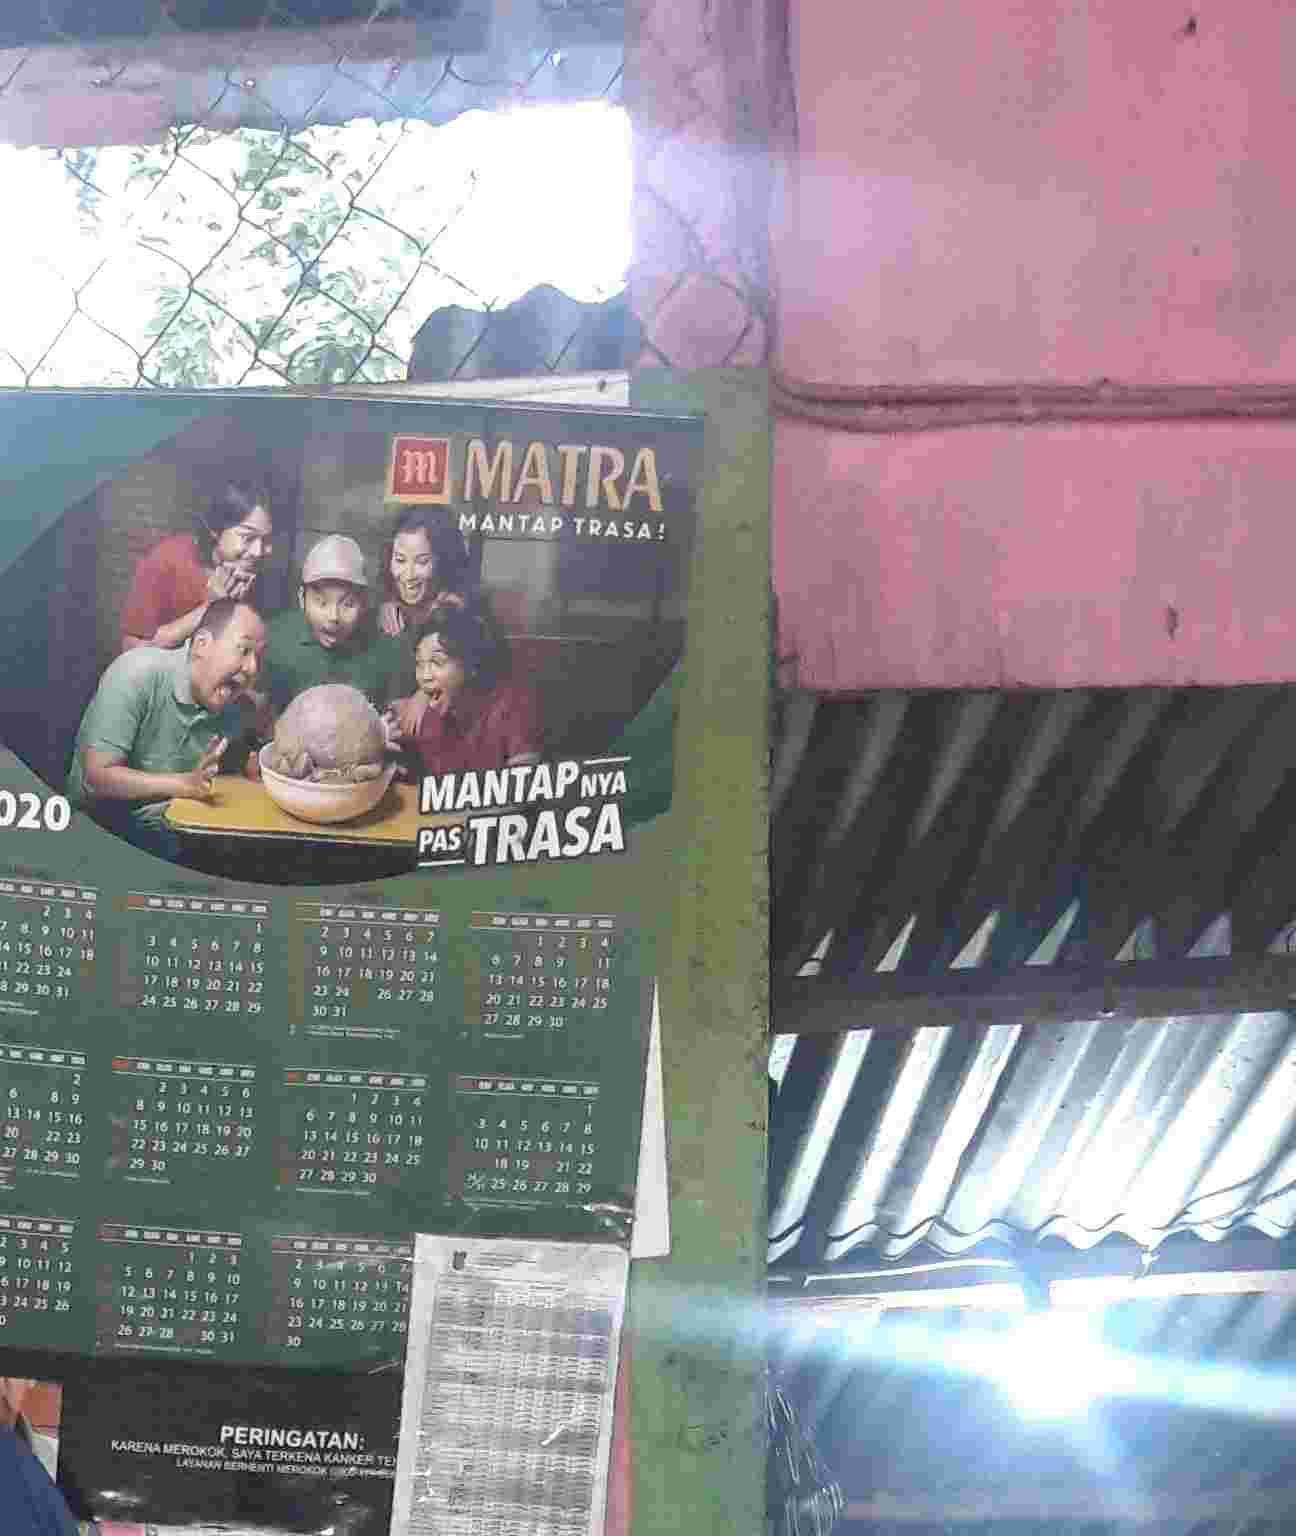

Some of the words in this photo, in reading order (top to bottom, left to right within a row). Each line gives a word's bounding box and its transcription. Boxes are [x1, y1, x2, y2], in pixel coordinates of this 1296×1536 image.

[463, 438, 664, 512] MATRA
[459, 511, 564, 534] MANTAP
[574, 516, 665, 541] TRASA!
[420, 760, 579, 813] MANTAP
[580, 770, 627, 799] NYA
[419, 826, 463, 853] PAS
[469, 803, 625, 866] TRASA
[111, 1440, 161, 1454] KARENA
[231, 1447, 263, 1461] SAYA
[265, 1449, 321, 1463] TERKENA
[220, 1425, 365, 1450] PERINGATAN:
